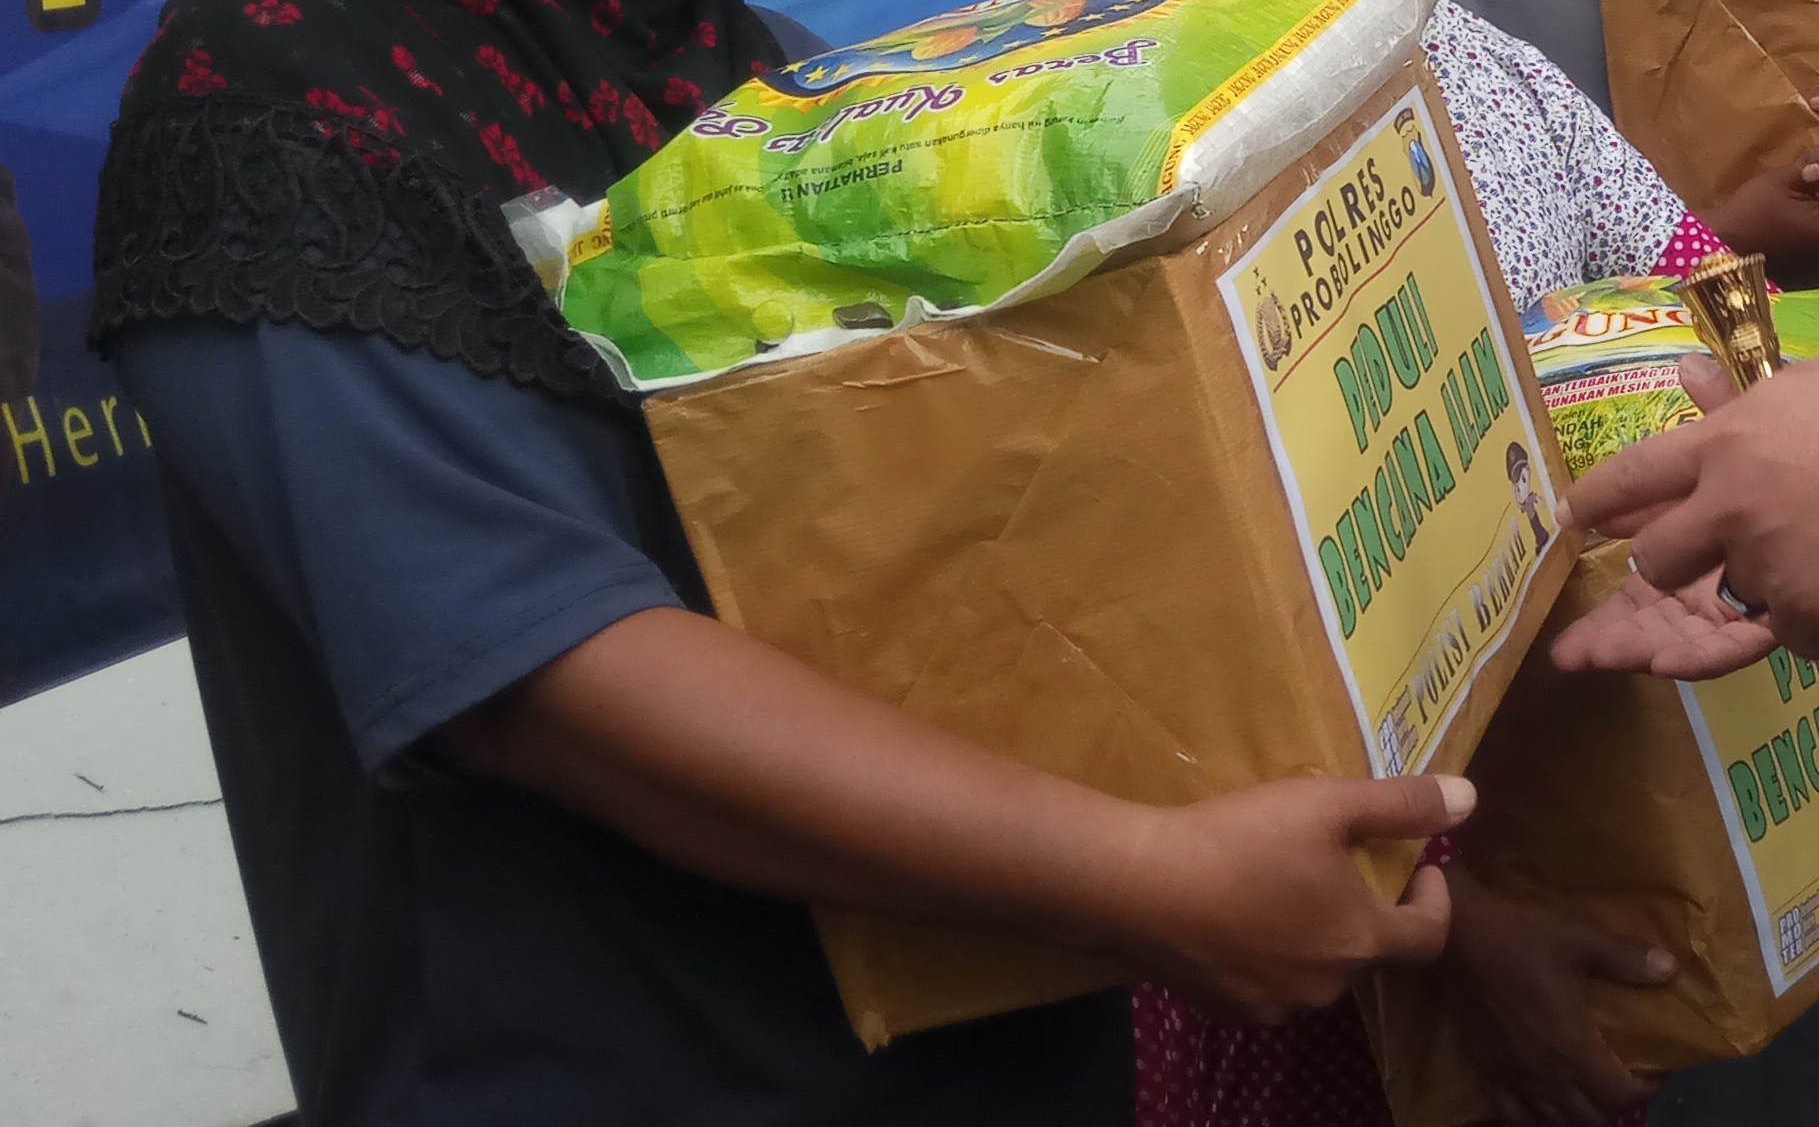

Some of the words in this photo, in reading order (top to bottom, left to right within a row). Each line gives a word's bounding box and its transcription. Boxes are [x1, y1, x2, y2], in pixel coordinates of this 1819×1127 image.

[987, 38, 1161, 88] Beras
[796, 158, 904, 202] PERHATIAN
[1292, 157, 1385, 278] POLRES
[1289, 185, 1416, 340] PROBOLINGGO
[1564, 373, 1621, 391] TERBAIK
[1607, 380, 1651, 397] MESIN
